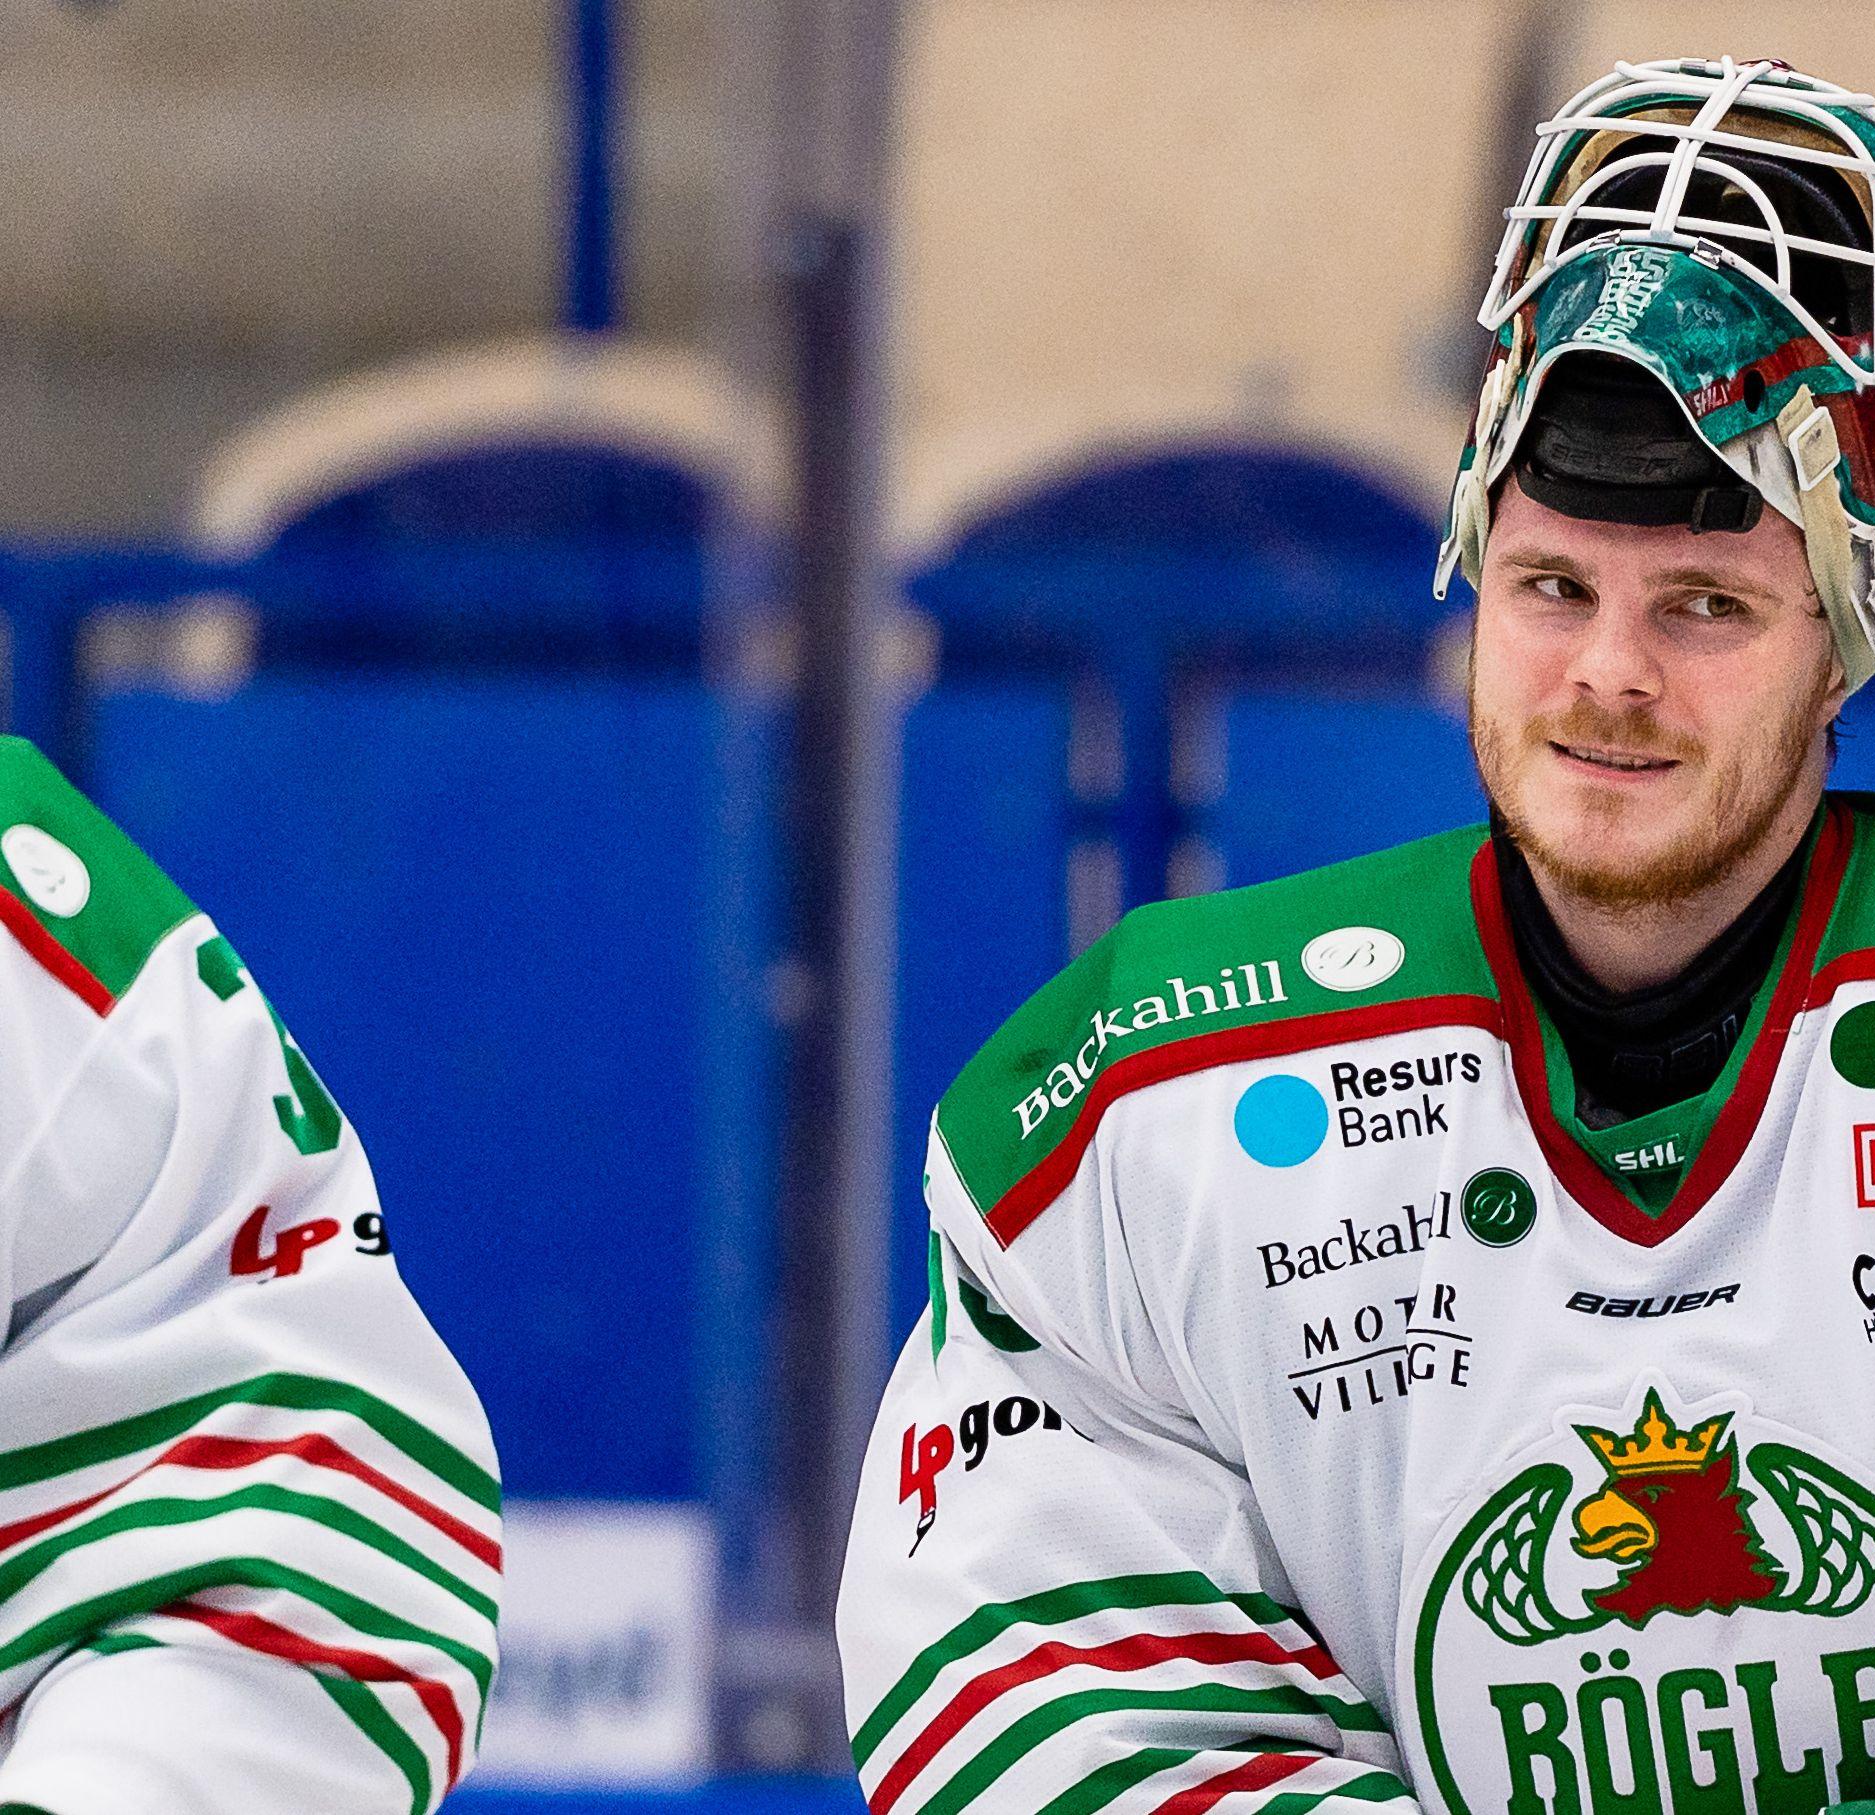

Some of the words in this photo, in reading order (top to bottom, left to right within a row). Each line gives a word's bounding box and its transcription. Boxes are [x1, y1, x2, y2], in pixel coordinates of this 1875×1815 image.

[1011, 959, 1289, 1141] Backahill
[1330, 1051, 1482, 1102] Resurs
[1338, 1093, 1449, 1148] Bank
[1614, 1141, 1686, 1171] SHL
[1303, 1283, 1456, 1360] MOTR
[899, 1422, 955, 1519] LP
